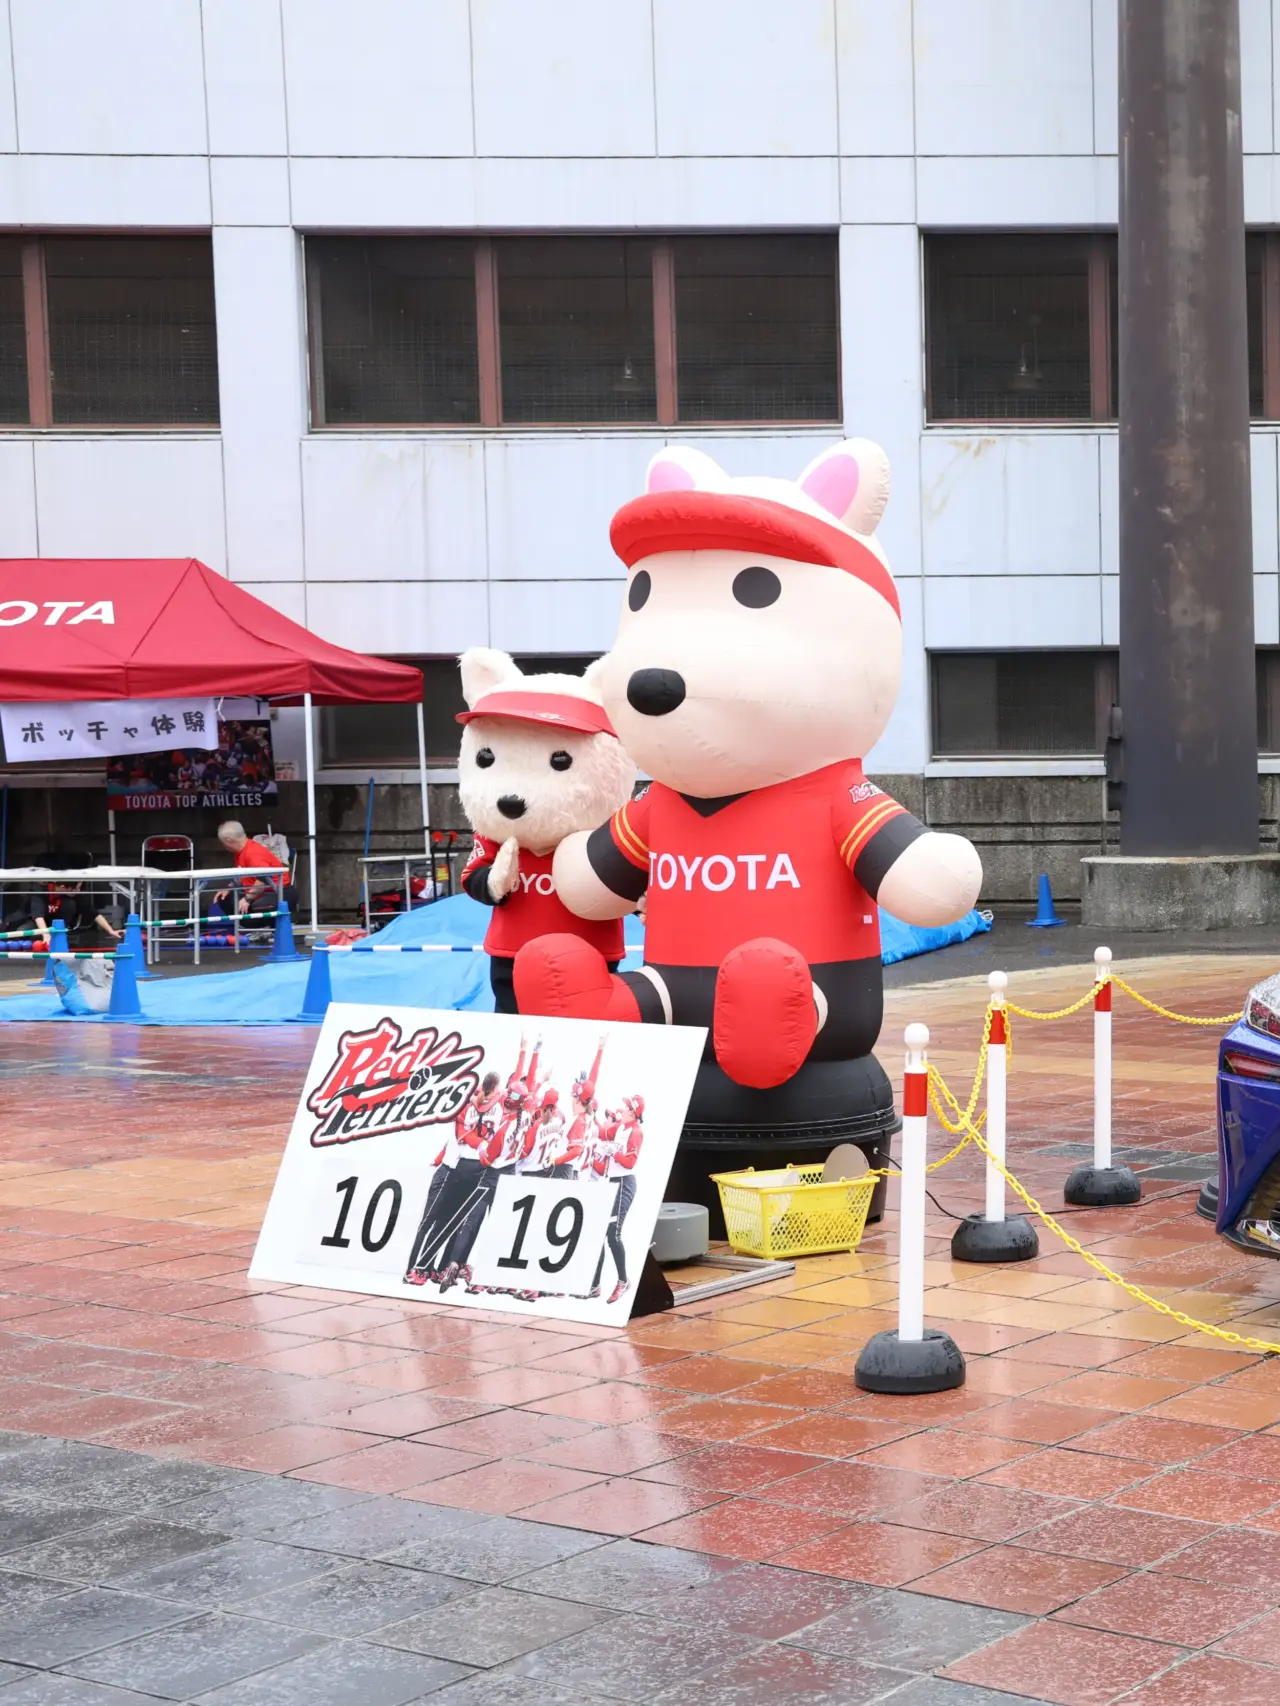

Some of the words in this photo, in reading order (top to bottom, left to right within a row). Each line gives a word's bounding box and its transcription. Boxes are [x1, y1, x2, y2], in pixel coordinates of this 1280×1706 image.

[125, 794, 171, 809] TOYOTA
[176, 794, 198, 808] TOP
[202, 793, 263, 807] ATHLETES
[648, 851, 801, 892] TOYOTA
[315, 1026, 434, 1103] Red
[320, 1081, 472, 1137] Terriers
